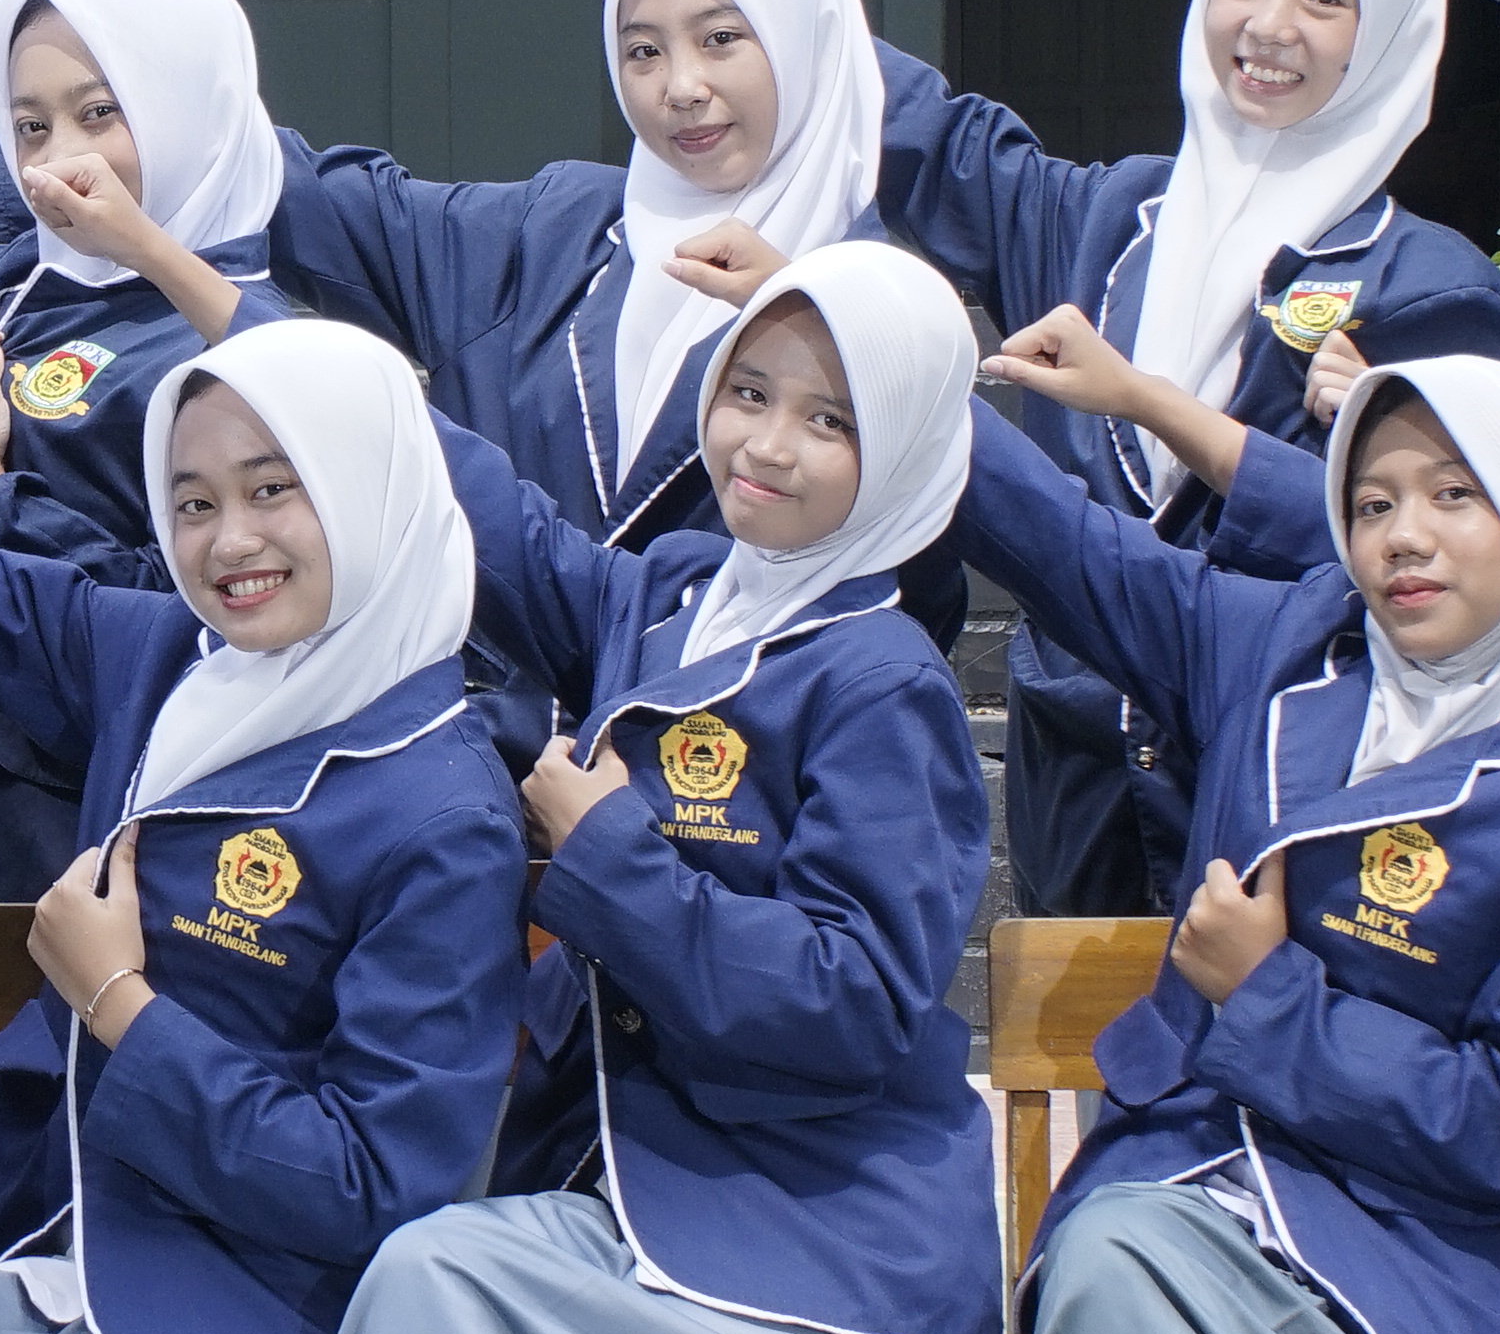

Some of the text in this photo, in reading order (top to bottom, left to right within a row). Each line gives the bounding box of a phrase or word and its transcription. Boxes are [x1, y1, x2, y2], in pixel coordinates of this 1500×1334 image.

[674, 802, 730, 827] MPK
[684, 824, 761, 845] PANDEGLANG
[206, 906, 262, 943] MPK
[1355, 903, 1411, 940] MPK
[171, 914, 205, 939] SMAN
[210, 929, 288, 967] PANDEGLANG
